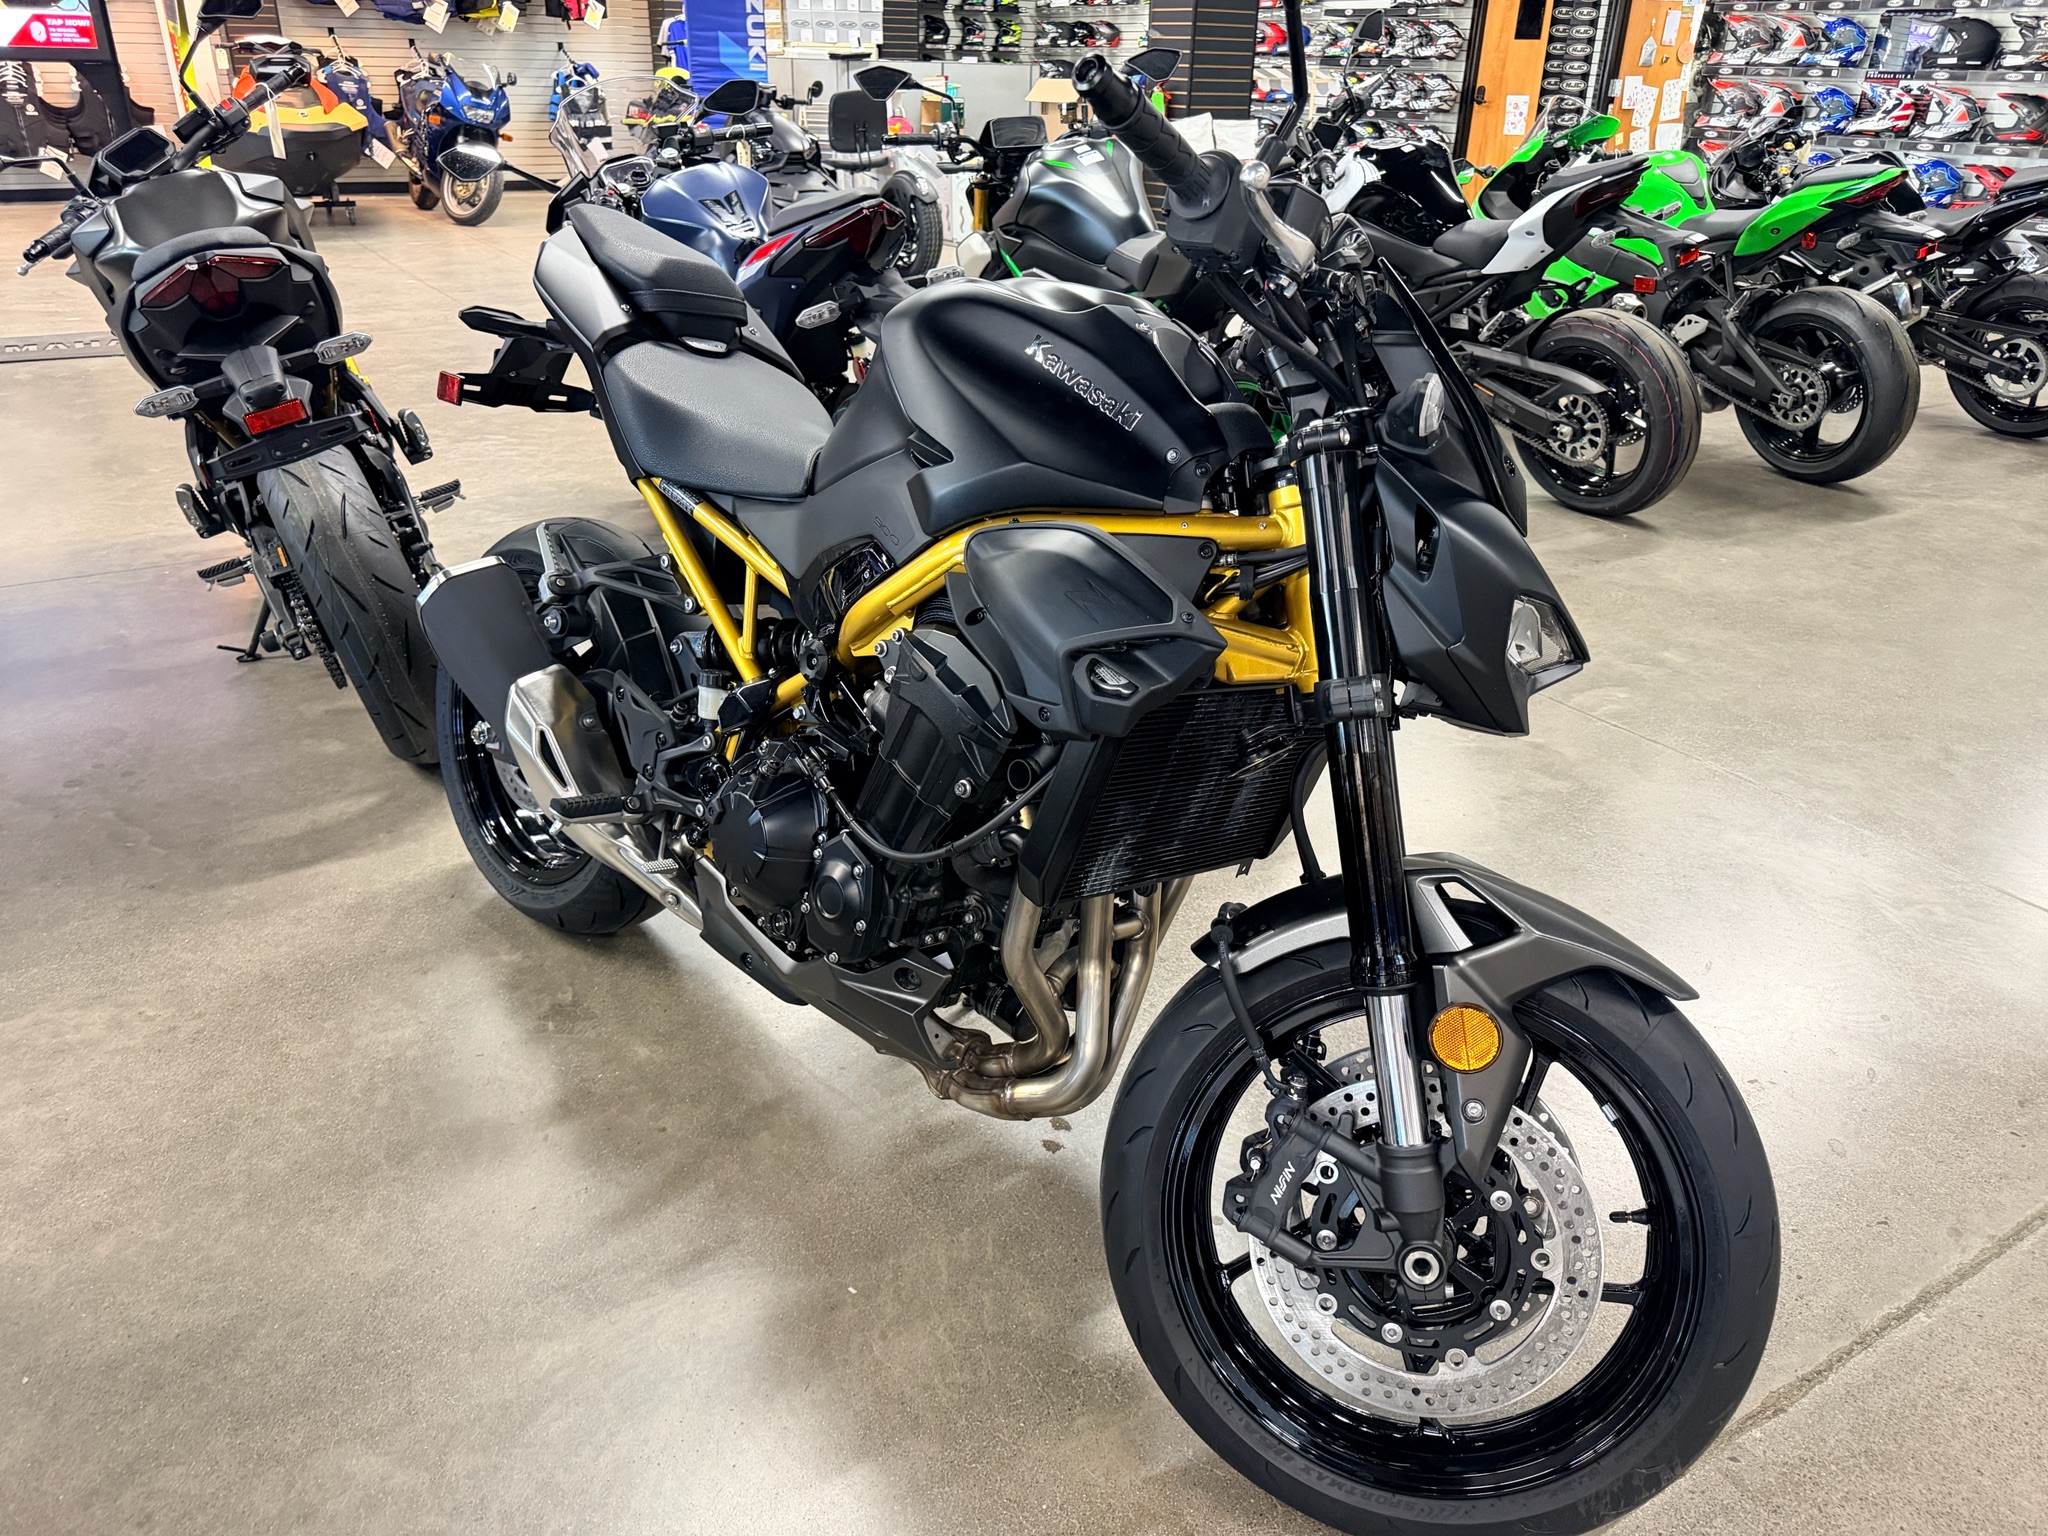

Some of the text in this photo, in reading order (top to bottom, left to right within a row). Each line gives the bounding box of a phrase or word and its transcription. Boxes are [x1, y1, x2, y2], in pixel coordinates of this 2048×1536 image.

[46, 18, 64, 26] TAP
[1814, 52, 1847, 61] SMK
[1025, 334, 1143, 432] Kawasaki
[1301, 1460, 1420, 1512] SPORTMAX
